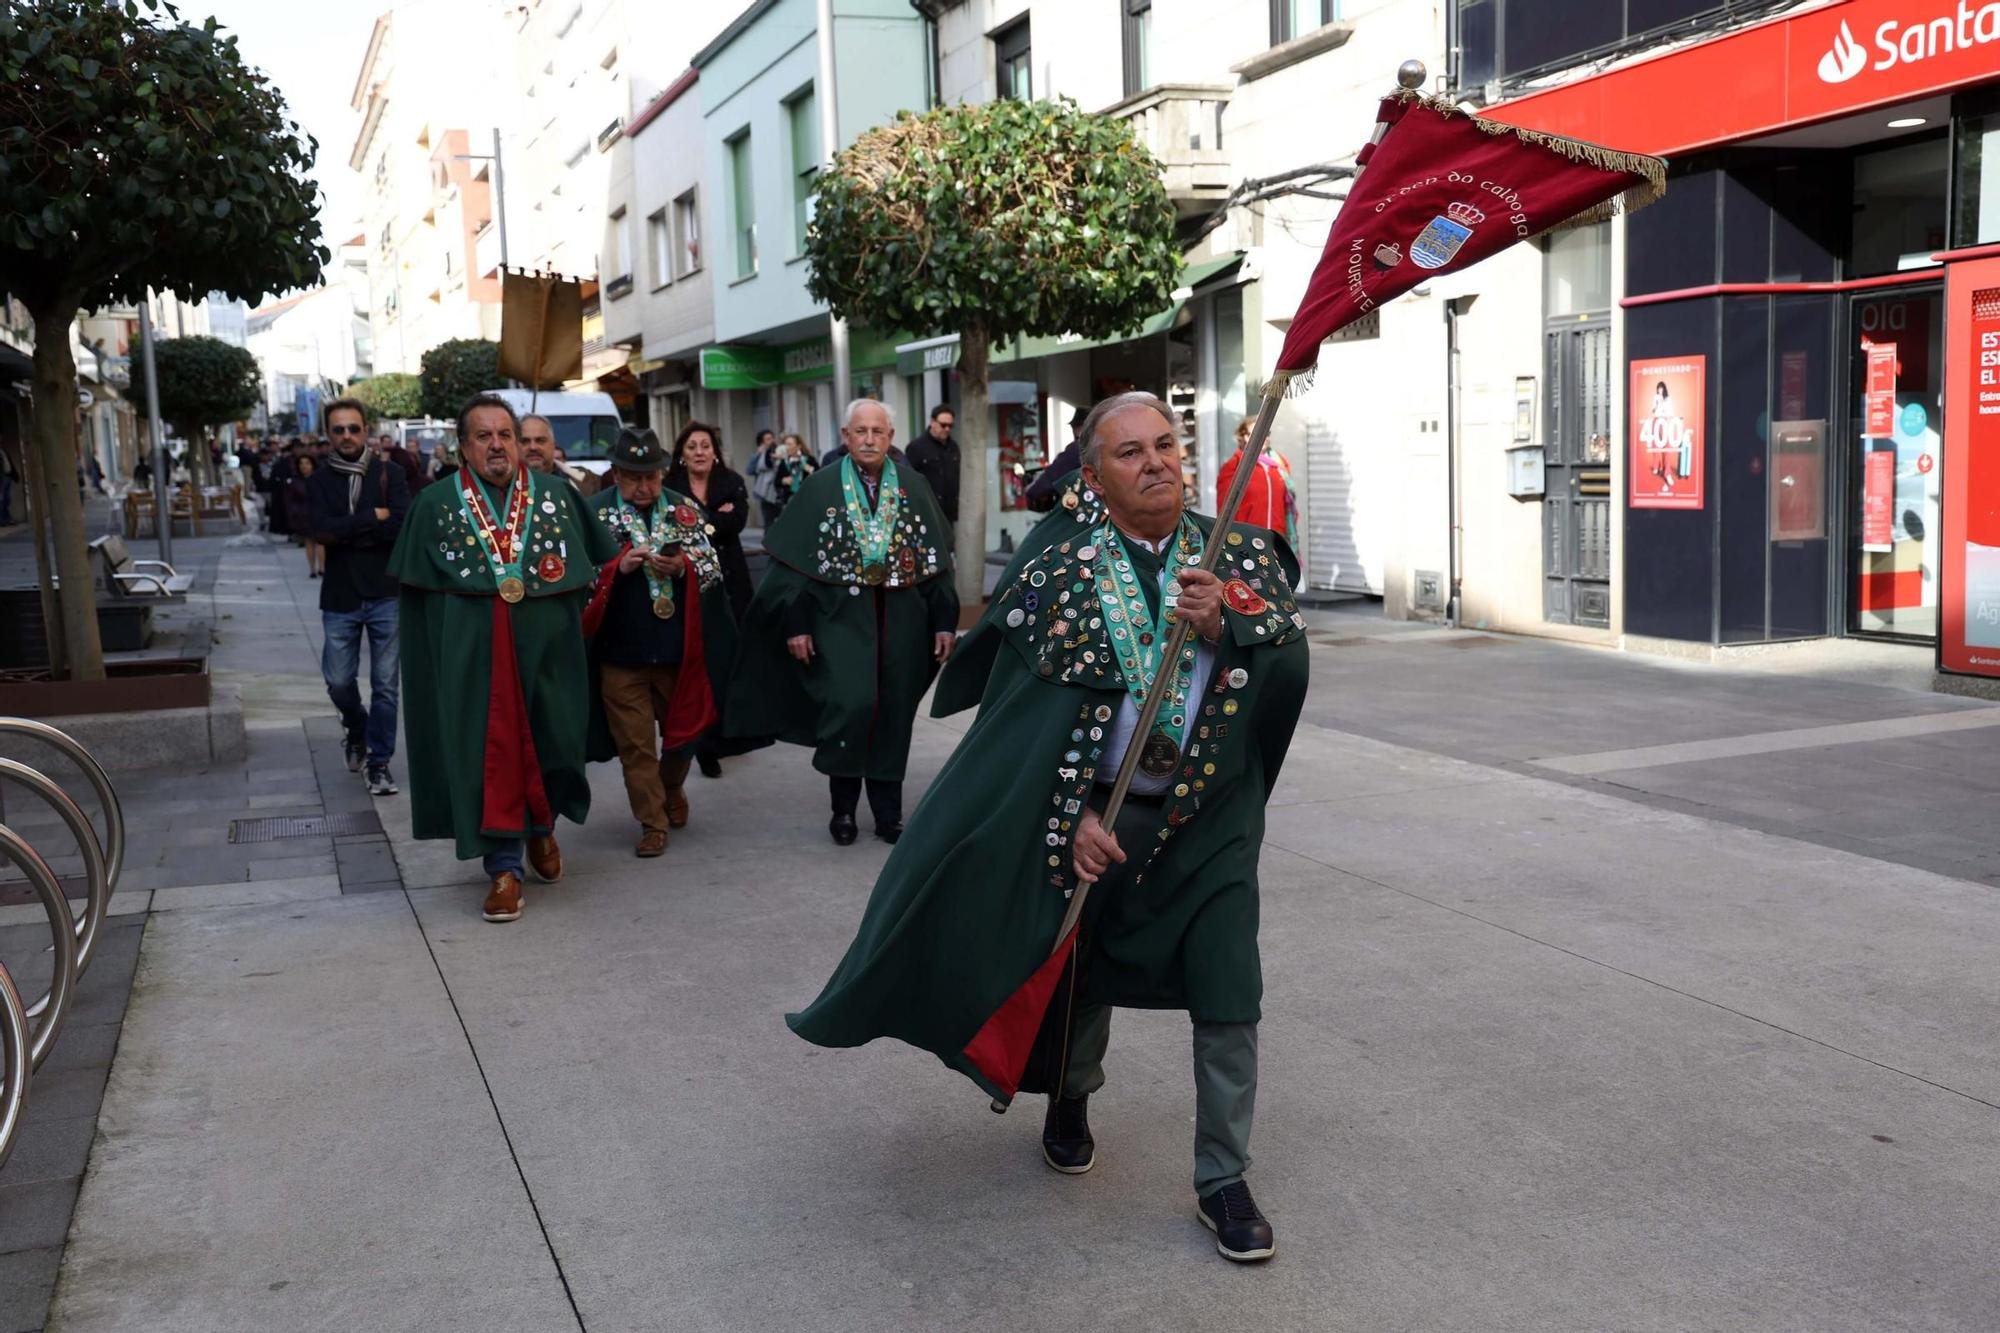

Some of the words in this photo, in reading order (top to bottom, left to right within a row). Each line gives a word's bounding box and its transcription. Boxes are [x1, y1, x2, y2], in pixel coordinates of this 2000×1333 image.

[1873, 0, 2000, 72] Santa
[1447, 170, 1474, 184] do
[1980, 369, 1997, 385] EL
